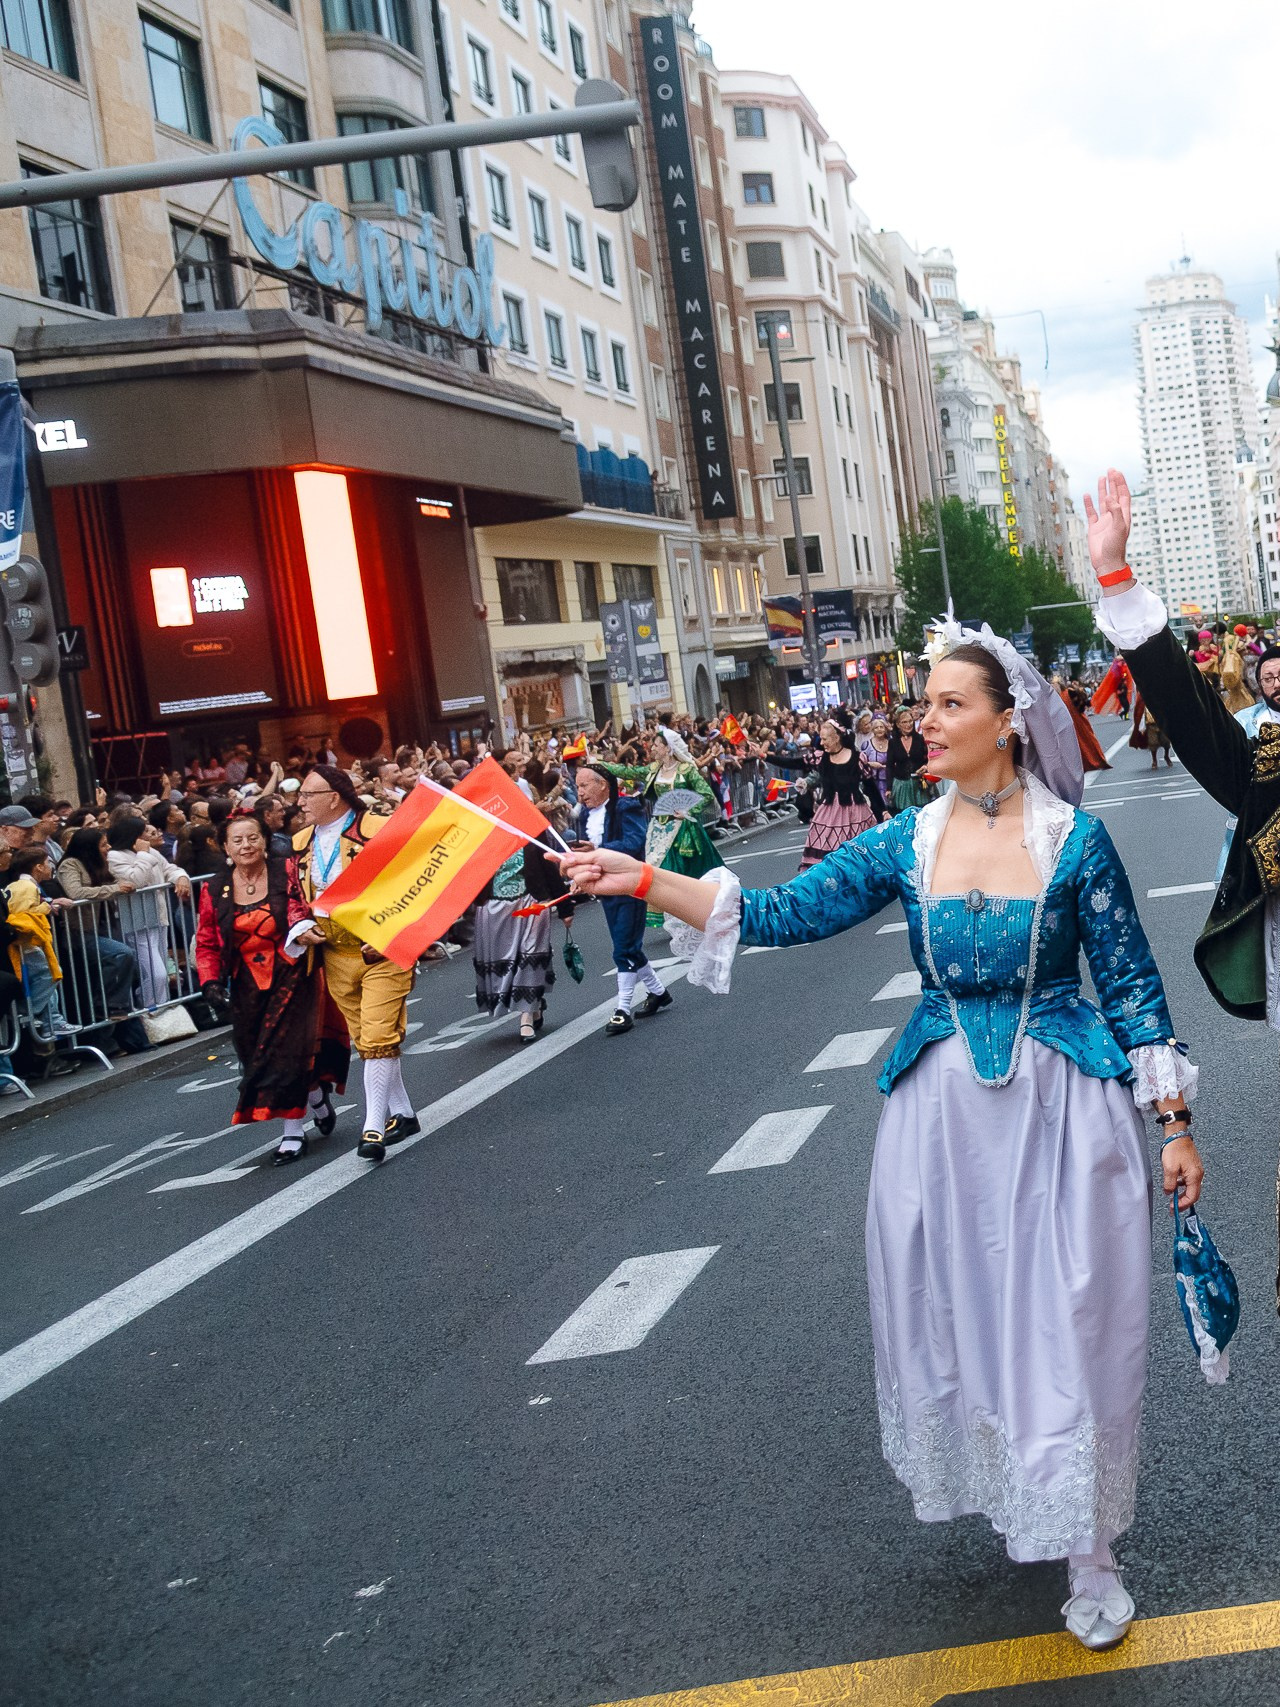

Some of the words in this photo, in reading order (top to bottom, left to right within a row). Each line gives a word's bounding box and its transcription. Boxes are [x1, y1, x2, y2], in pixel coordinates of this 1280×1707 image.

[231, 116, 505, 345] Capitol
[652, 28, 678, 129] ROOM
[668, 164, 691, 263] MATE
[685, 298, 725, 506] MACARENA
[993, 414, 1011, 484] HOTEL
[1004, 491, 1021, 566] EMPER
